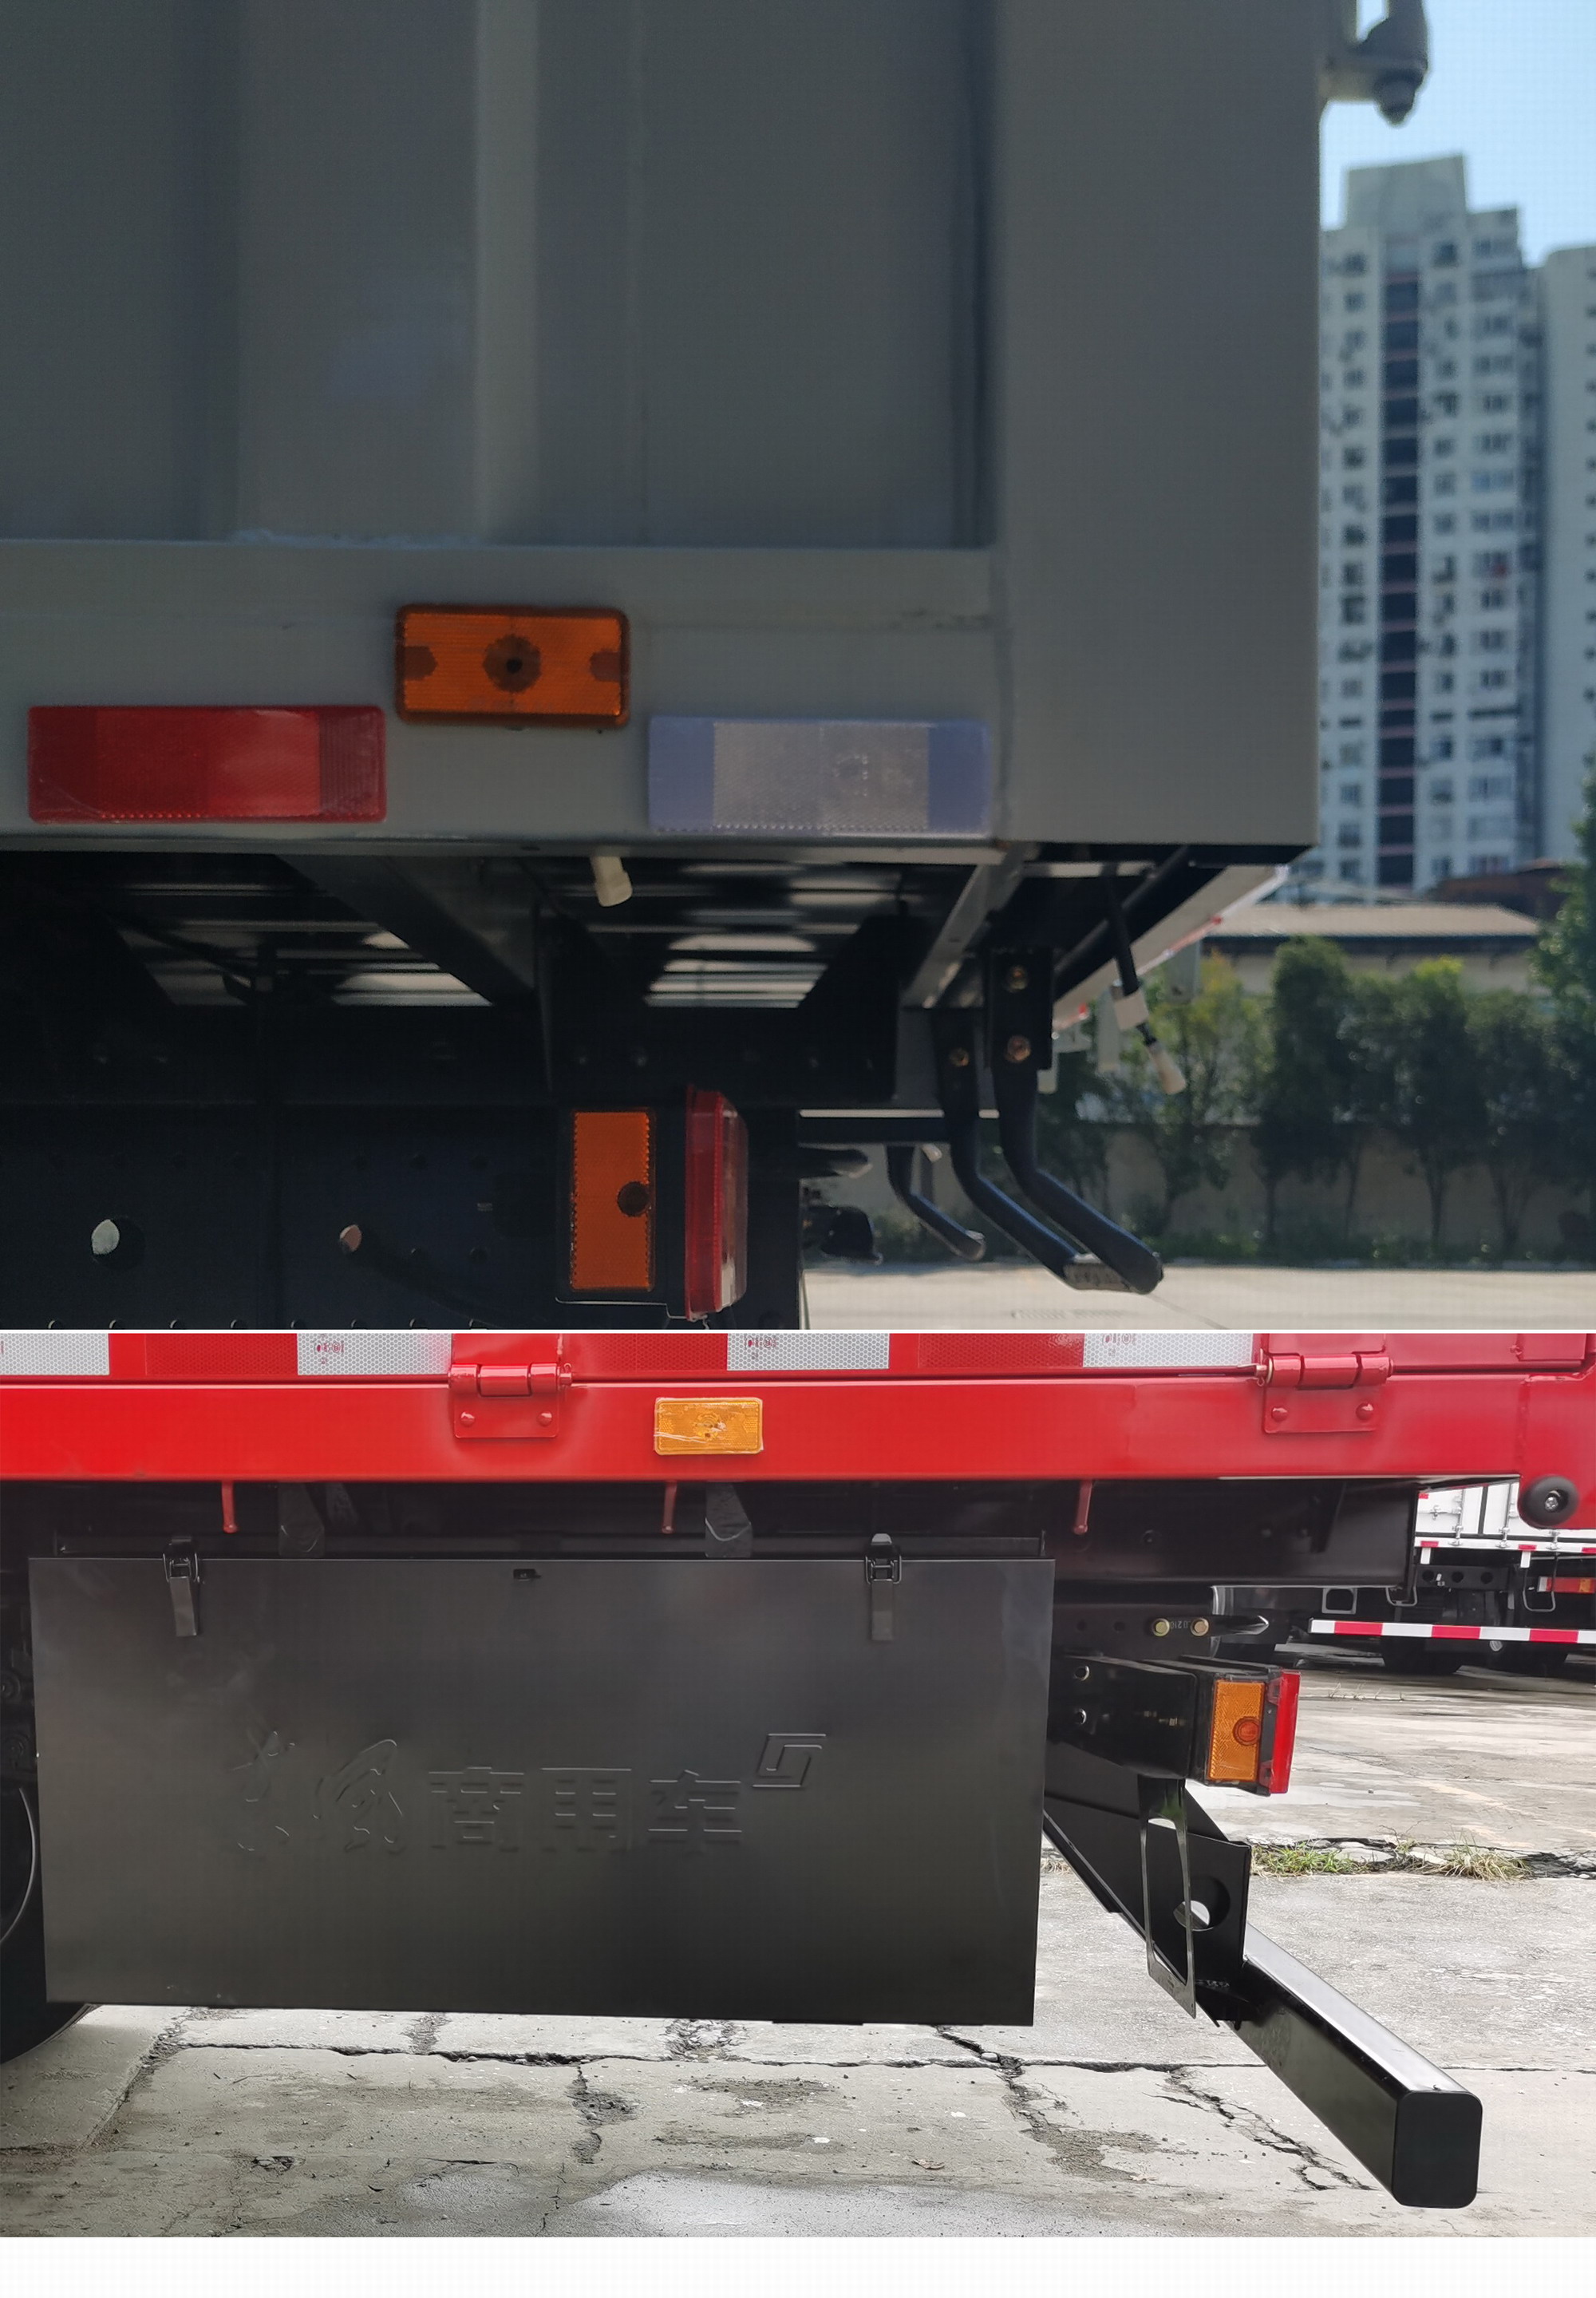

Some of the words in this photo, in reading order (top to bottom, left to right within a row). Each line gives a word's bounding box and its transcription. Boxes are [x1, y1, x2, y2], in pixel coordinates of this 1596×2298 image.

[231, 1730, 743, 1859] 东风商用车
